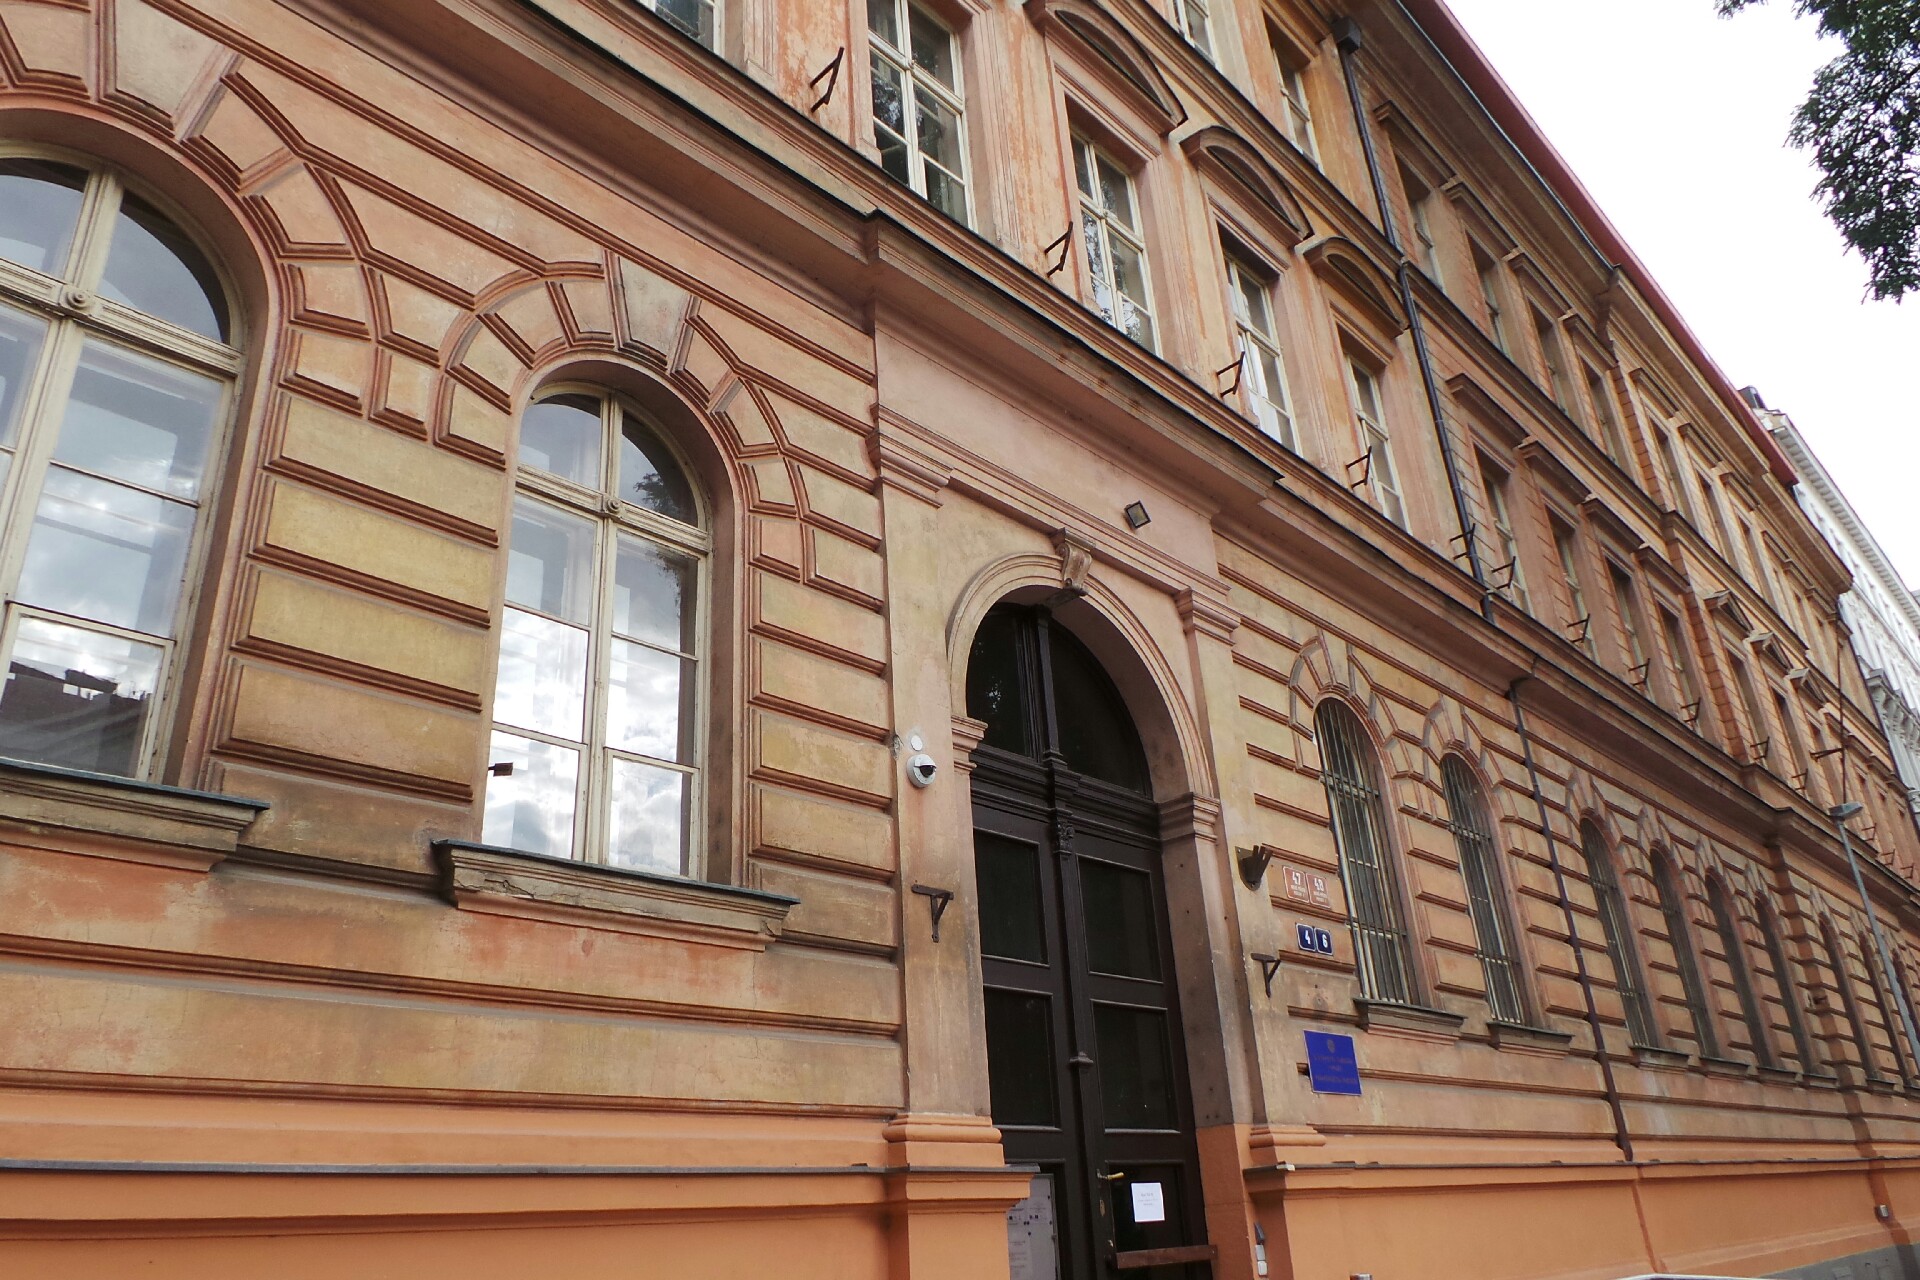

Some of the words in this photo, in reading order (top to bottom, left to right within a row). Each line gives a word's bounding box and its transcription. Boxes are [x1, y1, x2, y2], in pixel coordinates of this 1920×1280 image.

[1292, 871, 1301, 886] 47
[1304, 929, 1311, 945] 4
[1322, 933, 1328, 949] 6
